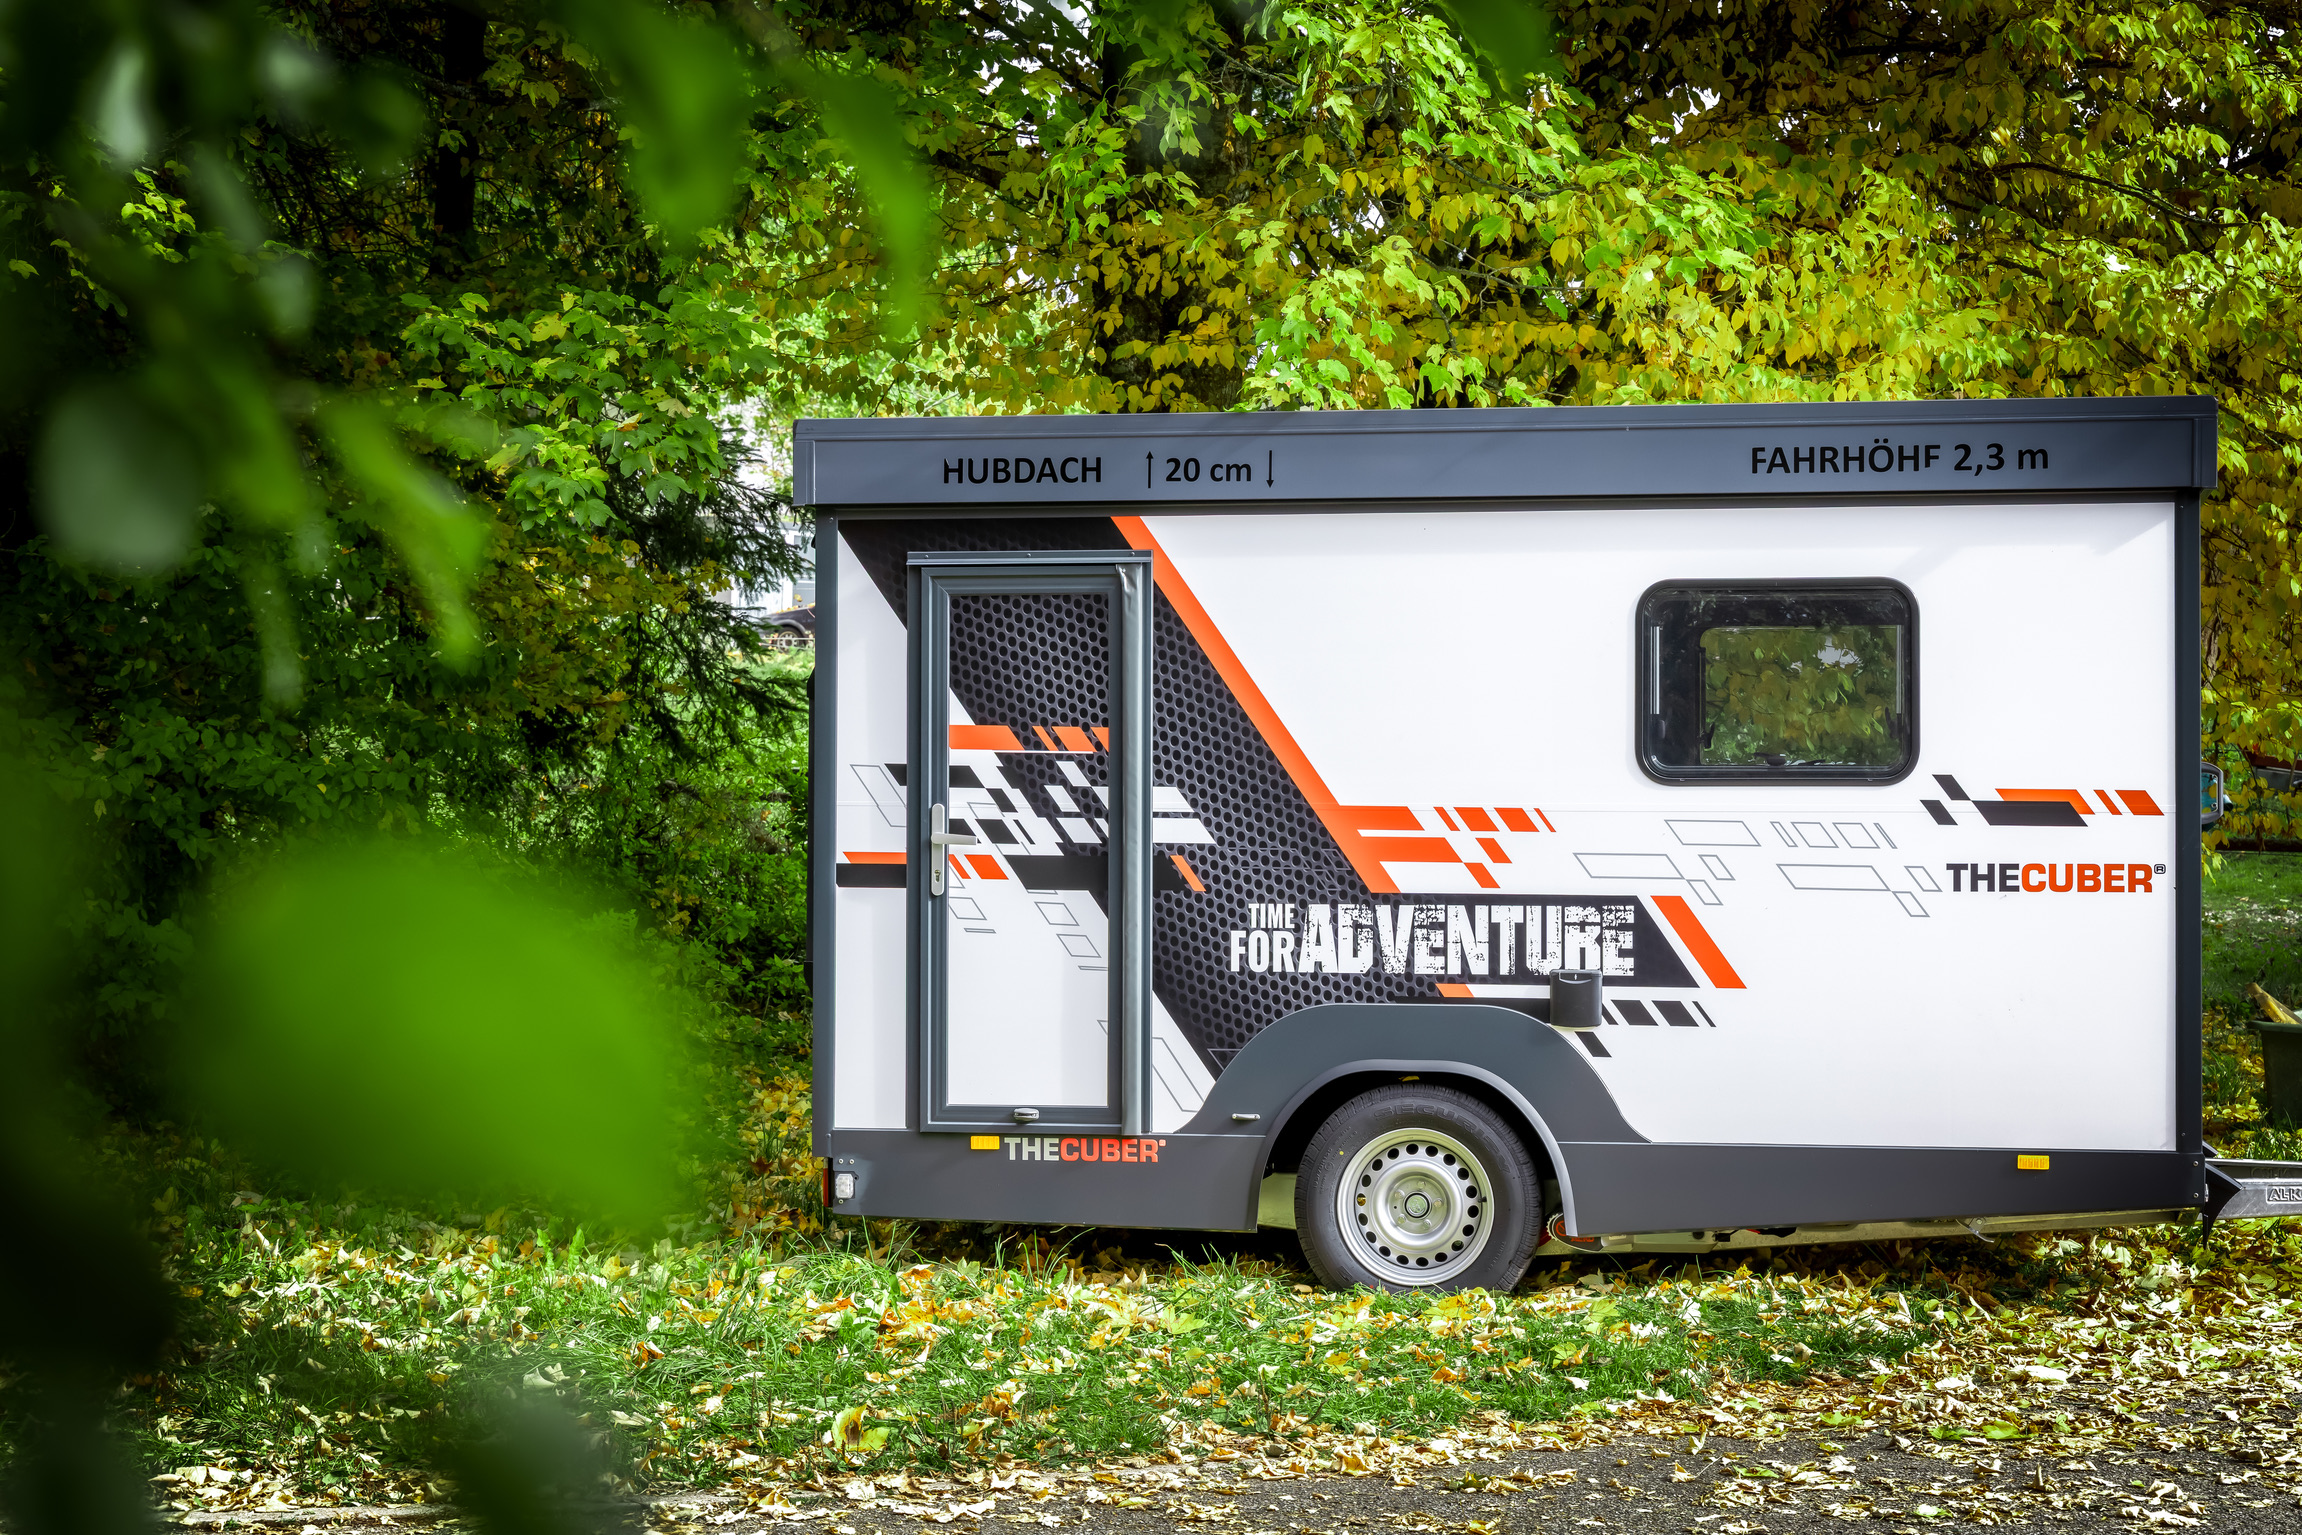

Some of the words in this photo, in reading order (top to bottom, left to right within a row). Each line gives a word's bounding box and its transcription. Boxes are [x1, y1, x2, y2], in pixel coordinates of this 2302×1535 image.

[943, 456, 1102, 485] HUBDACH
[1164, 456, 1201, 483] 20
[1209, 461, 1252, 483] cm
[1953, 443, 2006, 477] 2,3
[2017, 447, 2049, 470] m
[1247, 903, 1296, 930] TIME
[1229, 930, 1296, 974] FOR
[1298, 903, 1635, 976] ADVENTURE
[2268, 1187, 2302, 1202] AL-K
